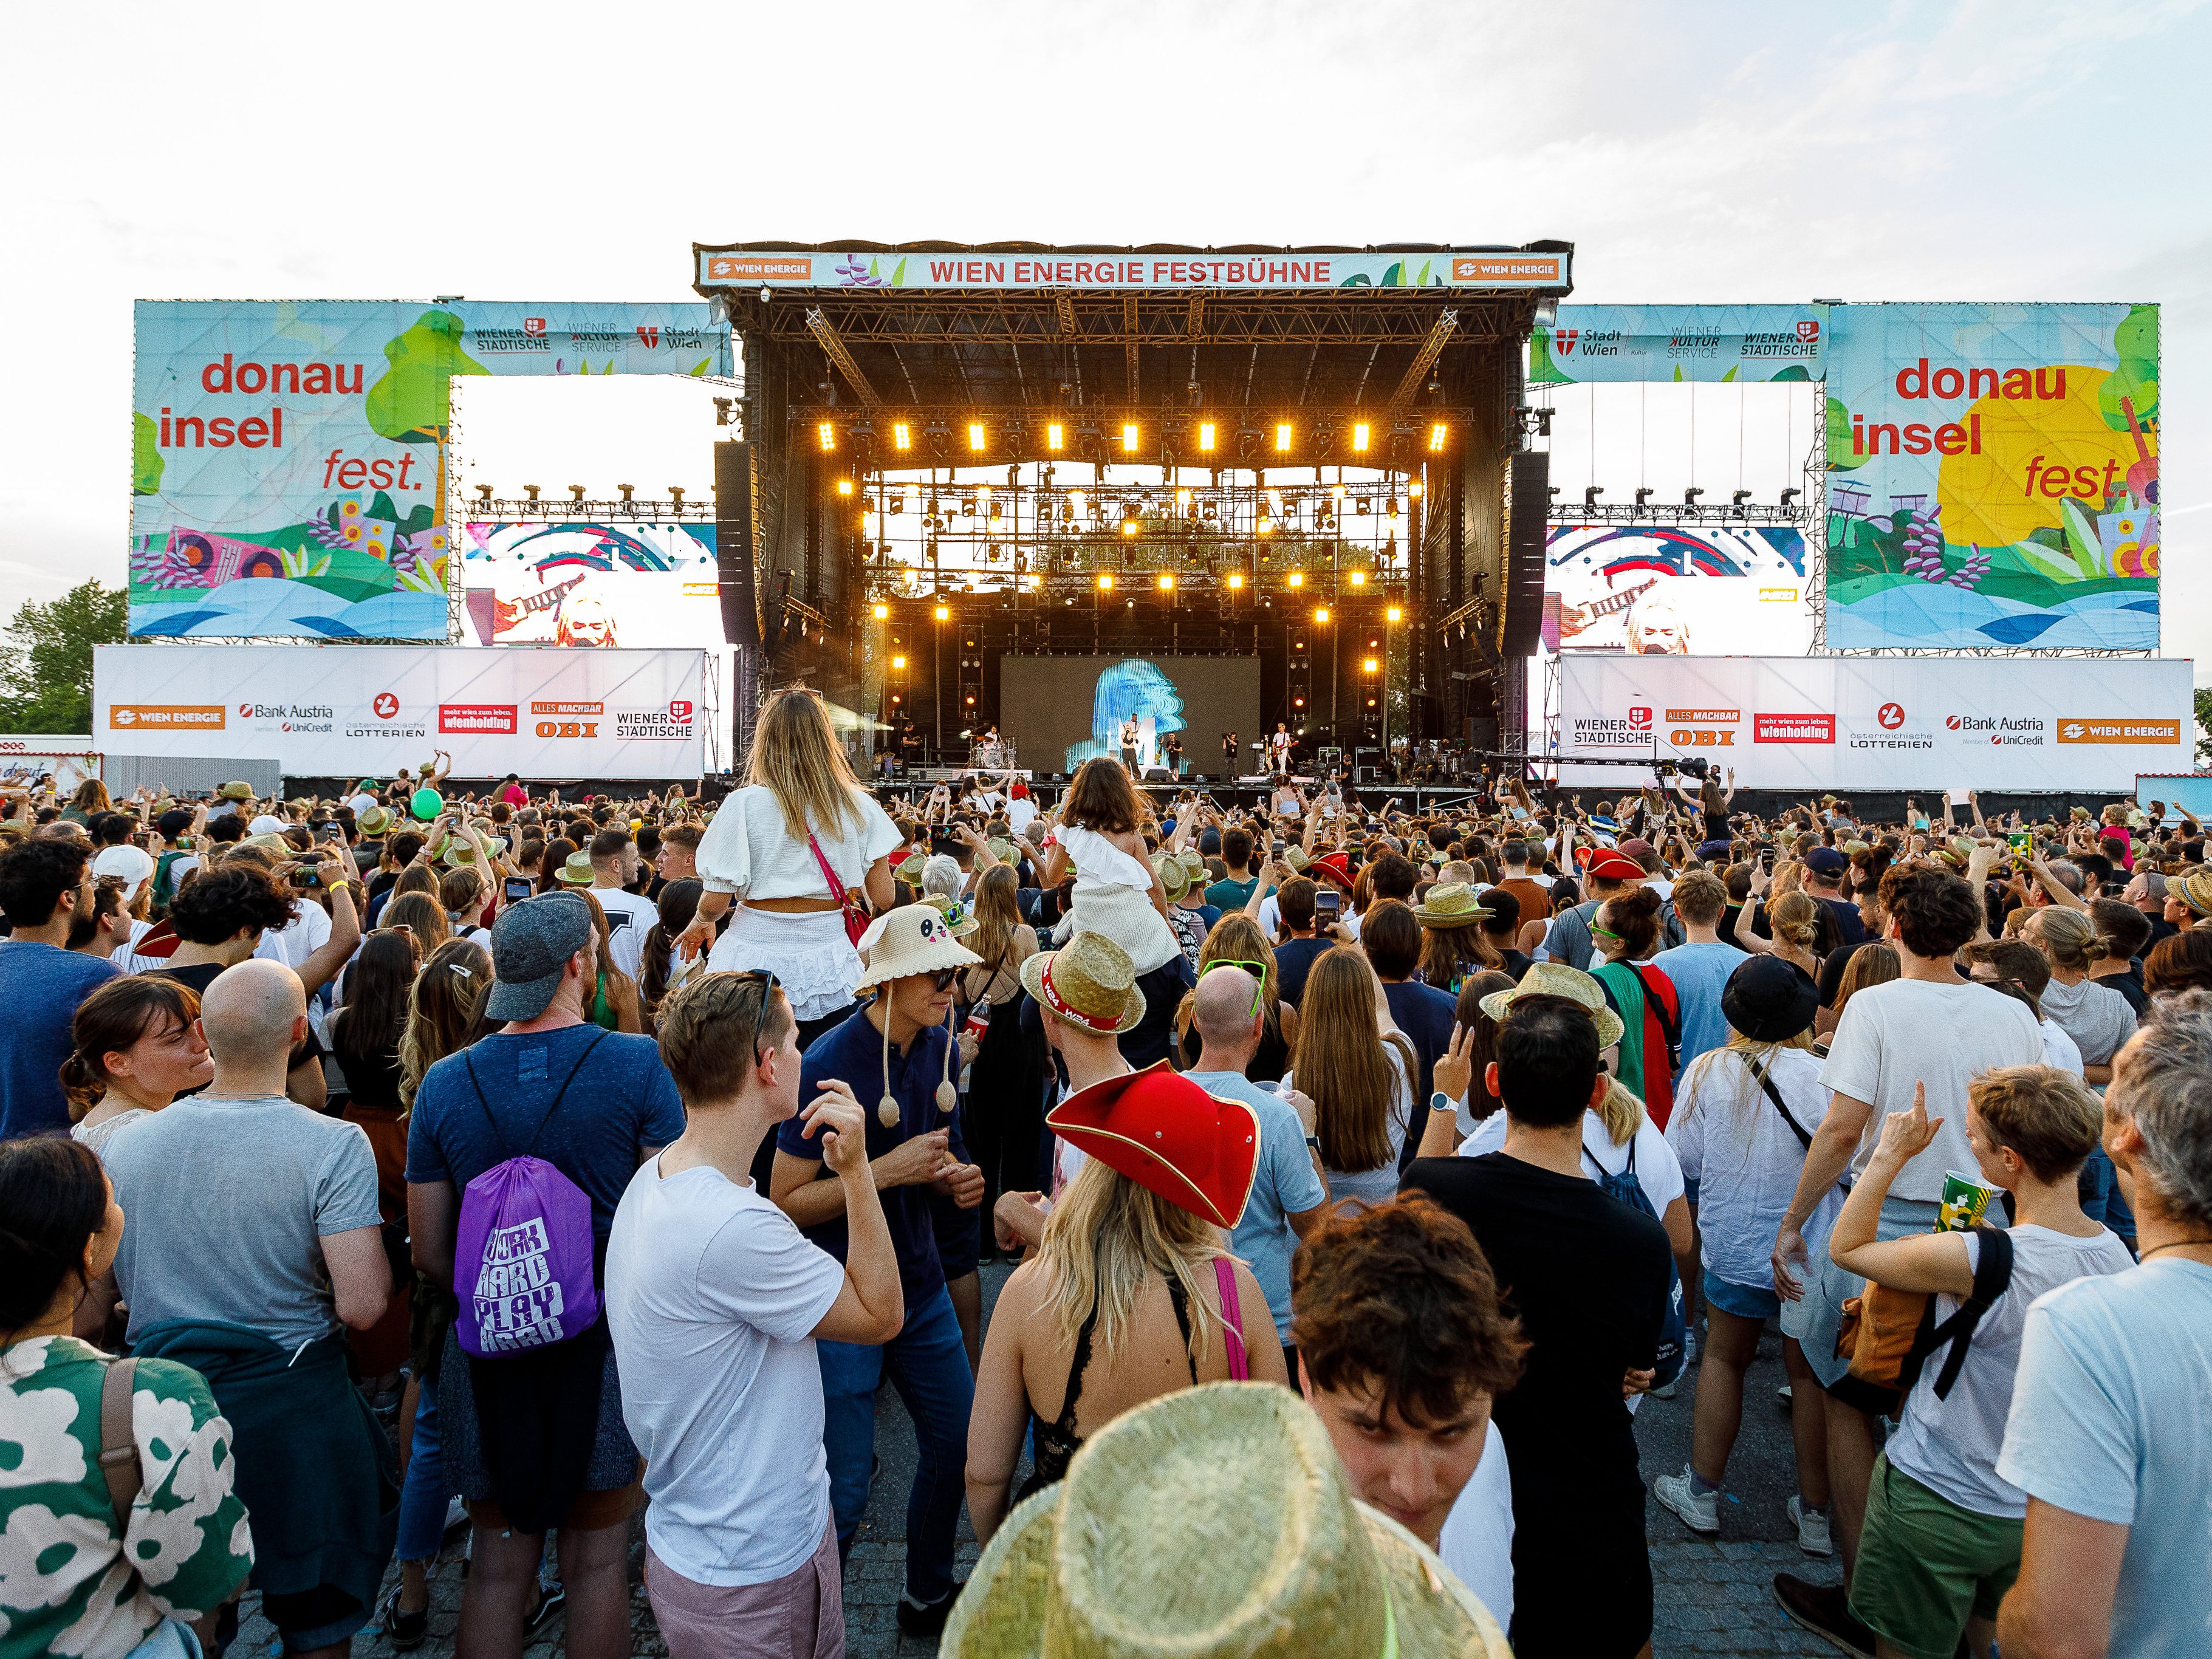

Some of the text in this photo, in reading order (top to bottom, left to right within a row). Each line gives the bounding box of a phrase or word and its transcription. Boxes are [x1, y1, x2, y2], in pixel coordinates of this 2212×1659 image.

[735, 264, 807, 274] WIEN ENERGIE
[930, 258, 1330, 282] WIEN ENERGIE FESTBÜHNE
[1481, 265, 1555, 274] WIEN ENERGIE
[474, 328, 525, 338] WIENER
[567, 322, 617, 333] WIENER
[664, 326, 700, 337] Stadt
[1672, 326, 1722, 337] WIENER
[1584, 329, 1621, 341] Stadt
[1745, 332, 1795, 343] WIENER
[477, 339, 551, 351] STÄDTISCHE
[572, 341, 621, 353] SERVICE
[667, 338, 702, 349] Wien
[1583, 343, 1618, 356] Wien
[1741, 344, 1818, 355] STÄDTISCHE
[1667, 347, 1718, 358] SERVICE
[202, 353, 363, 394] donau
[1895, 358, 2066, 400] donau
[160, 406, 282, 448] insel
[1853, 414, 1981, 456] insel
[323, 449, 422, 490] fest.
[2025, 456, 2128, 498] fest.
[255, 704, 333, 718] Bank Austria
[533, 704, 601, 713] ALLES MACHBAR
[139, 713, 222, 723] WIEN ENERGIE
[617, 713, 668, 724] WIENER
[1668, 711, 1738, 720] ALLES MACHBAR
[292, 723, 332, 733] UniCredit
[536, 722, 599, 737] OBI
[1575, 719, 1627, 730] WIENER
[1963, 716, 2044, 731] Bank Austria
[617, 725, 693, 737] STÄDTISCHE
[2089, 726, 2174, 737] WIEN ENERGIE
[1575, 731, 1652, 744] STÄDTISCHE
[1671, 730, 1735, 746] OBI
[2003, 736, 2044, 745] UniCredit
[1045, 982, 1060, 1007] W24
[1065, 1008, 1090, 1026] W24
[475, 1285, 555, 1332] PLAY
